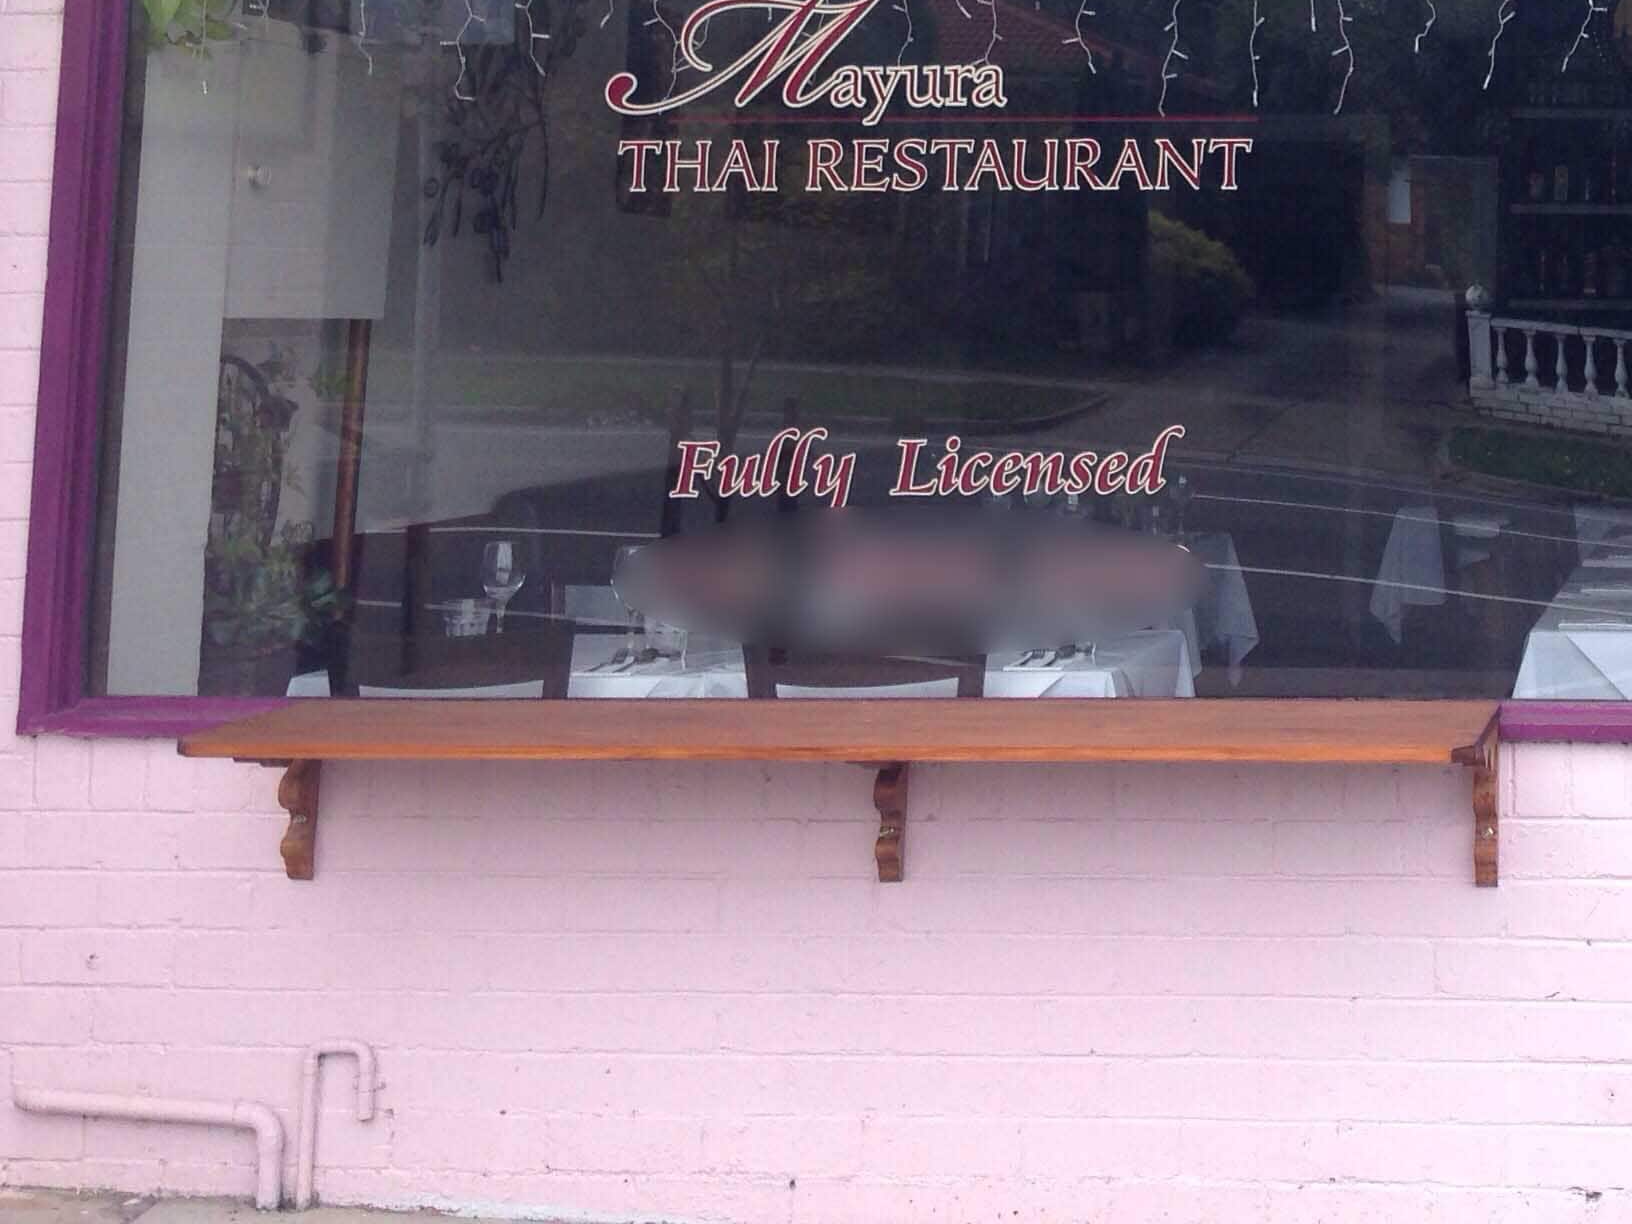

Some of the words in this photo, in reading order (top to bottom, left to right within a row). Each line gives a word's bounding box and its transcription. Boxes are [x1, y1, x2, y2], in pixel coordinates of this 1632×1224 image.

[618, 139, 781, 192] THAI
[805, 137, 1253, 192] RESTAURANT
[669, 427, 857, 511] Fully
[889, 425, 1185, 497] Licensed
